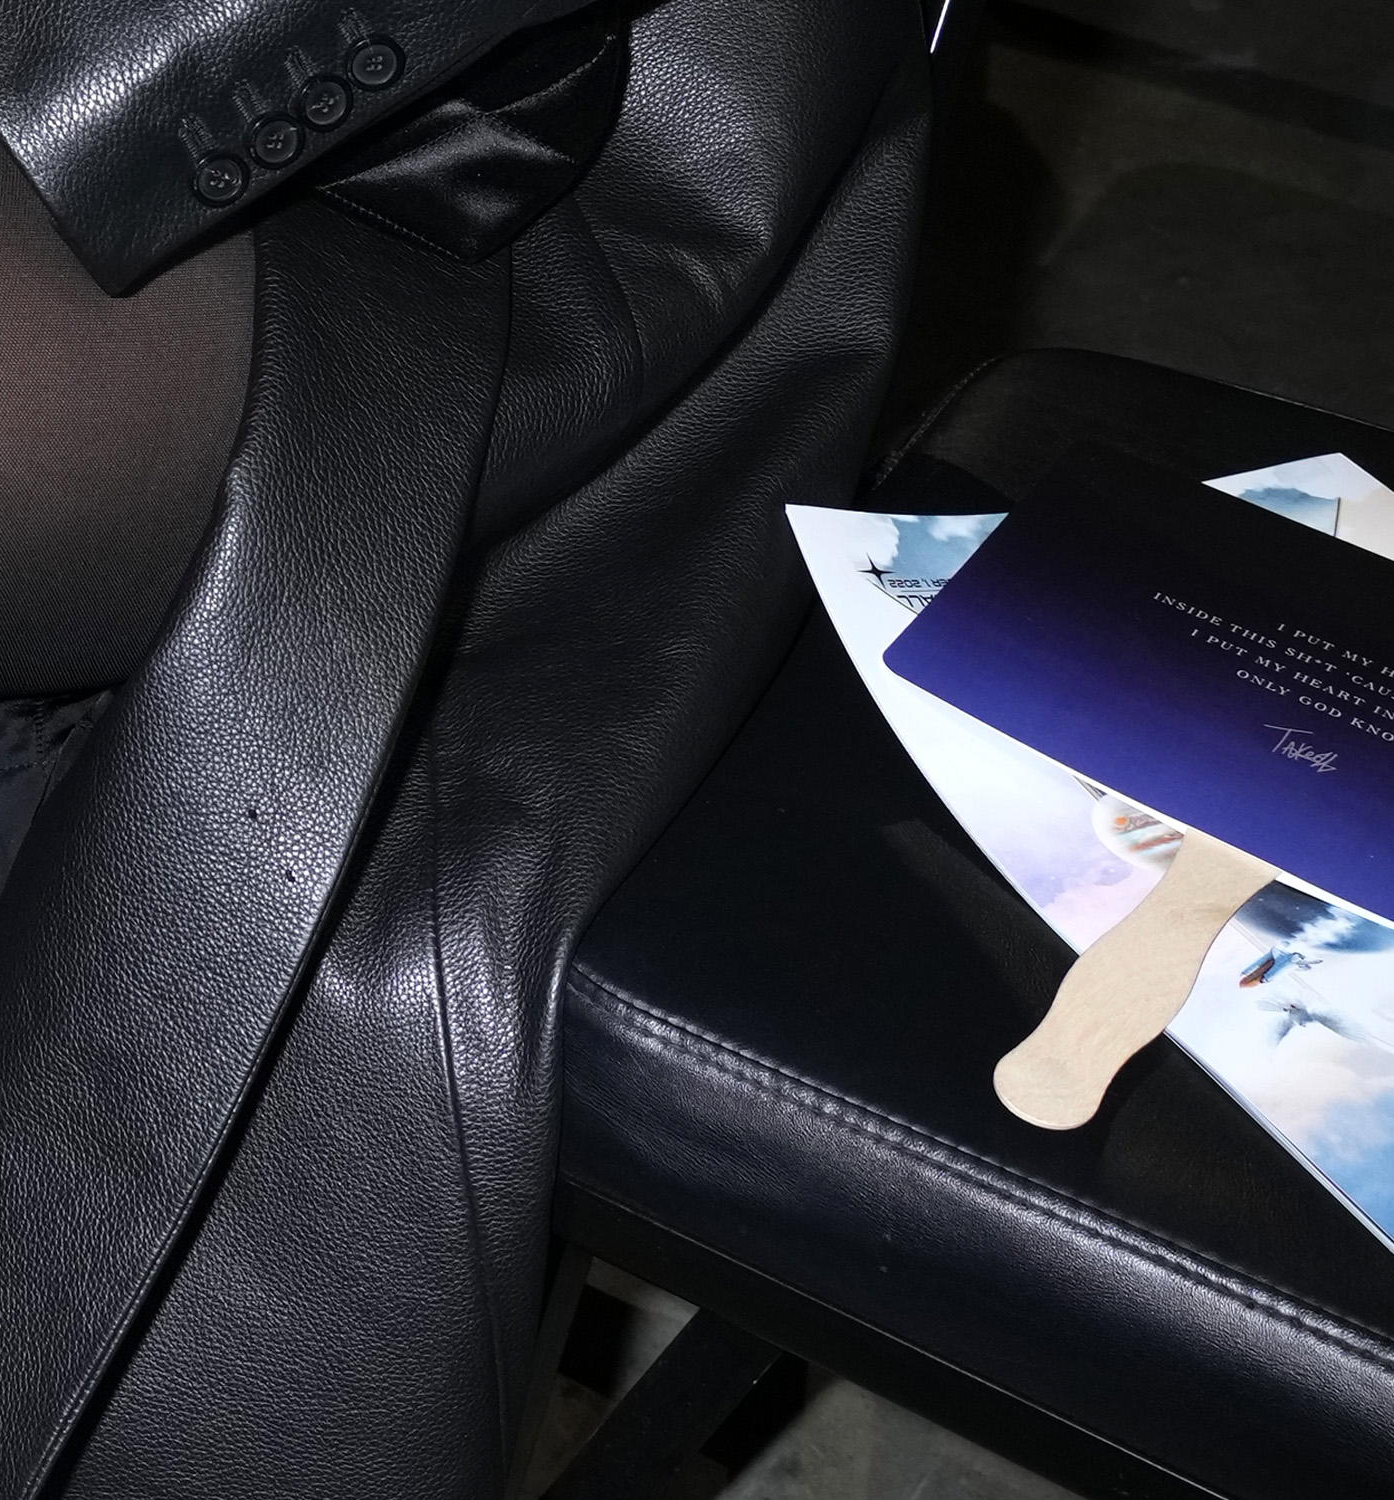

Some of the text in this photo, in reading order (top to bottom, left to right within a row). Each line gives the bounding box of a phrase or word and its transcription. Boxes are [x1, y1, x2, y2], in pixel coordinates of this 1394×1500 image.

[1153, 592, 1223, 627] INSIDE
[1230, 623, 1278, 649] THIS
[1277, 623, 1286, 632] I
[1293, 630, 1336, 651] PUT
[1342, 650, 1374, 668] MY
[1191, 628, 1200, 638] I
[1206, 635, 1249, 657] PUT
[1254, 656, 1286, 673] MY
[1293, 672, 1367, 707] HEART
[1236, 669, 1291, 697] ONLY
[1299, 695, 1343, 718] GOD
